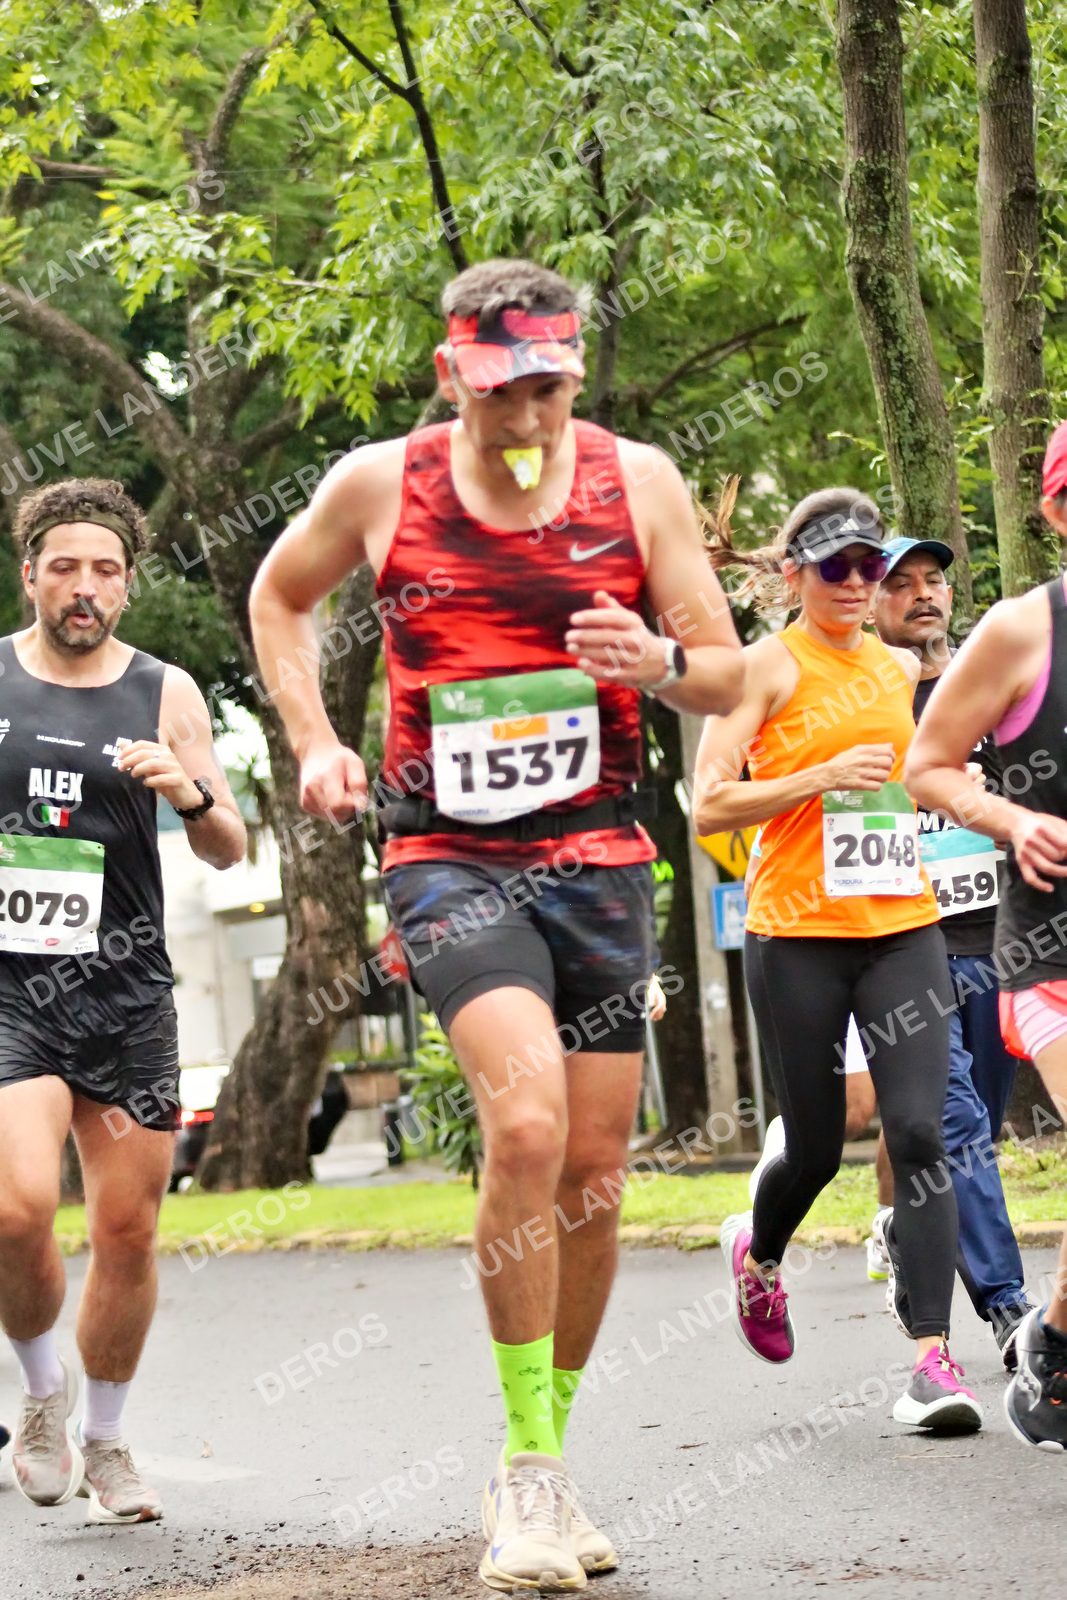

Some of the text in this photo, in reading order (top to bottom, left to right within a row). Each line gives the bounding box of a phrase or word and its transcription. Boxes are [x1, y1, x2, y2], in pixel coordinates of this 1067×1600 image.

[452, 736, 588, 793] 1537
[28, 767, 84, 801] ALEX
[832, 833, 916, 868] 2048
[0, 888, 89, 928] 079
